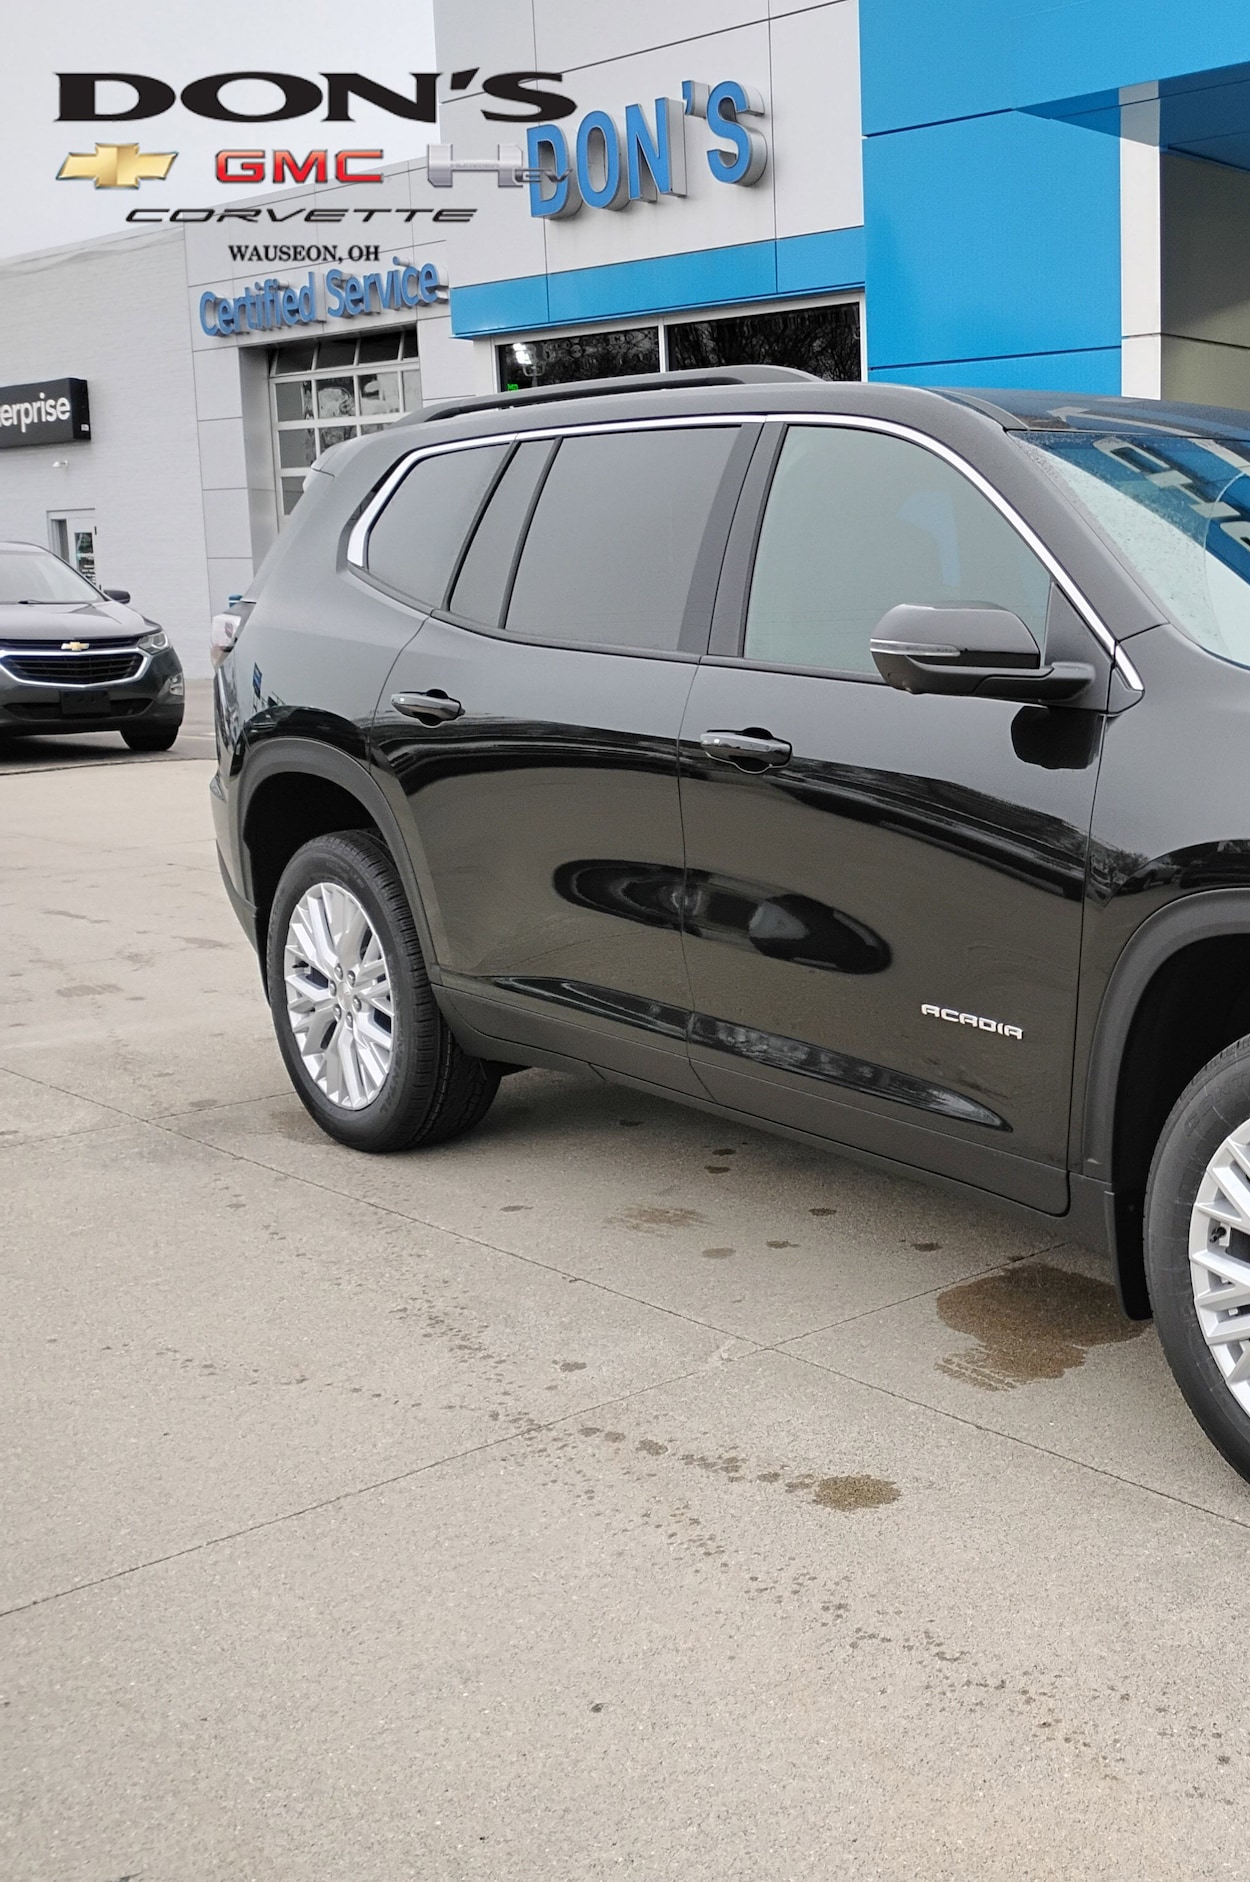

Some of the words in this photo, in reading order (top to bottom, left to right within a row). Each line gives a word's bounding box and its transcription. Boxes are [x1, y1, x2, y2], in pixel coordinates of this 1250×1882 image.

[527, 80, 768, 218] DON'S
[199, 265, 319, 337] Certified
[326, 256, 440, 319] Service
[0, 392, 71, 433] erprise
[920, 1003, 1024, 1040] ACADIA
